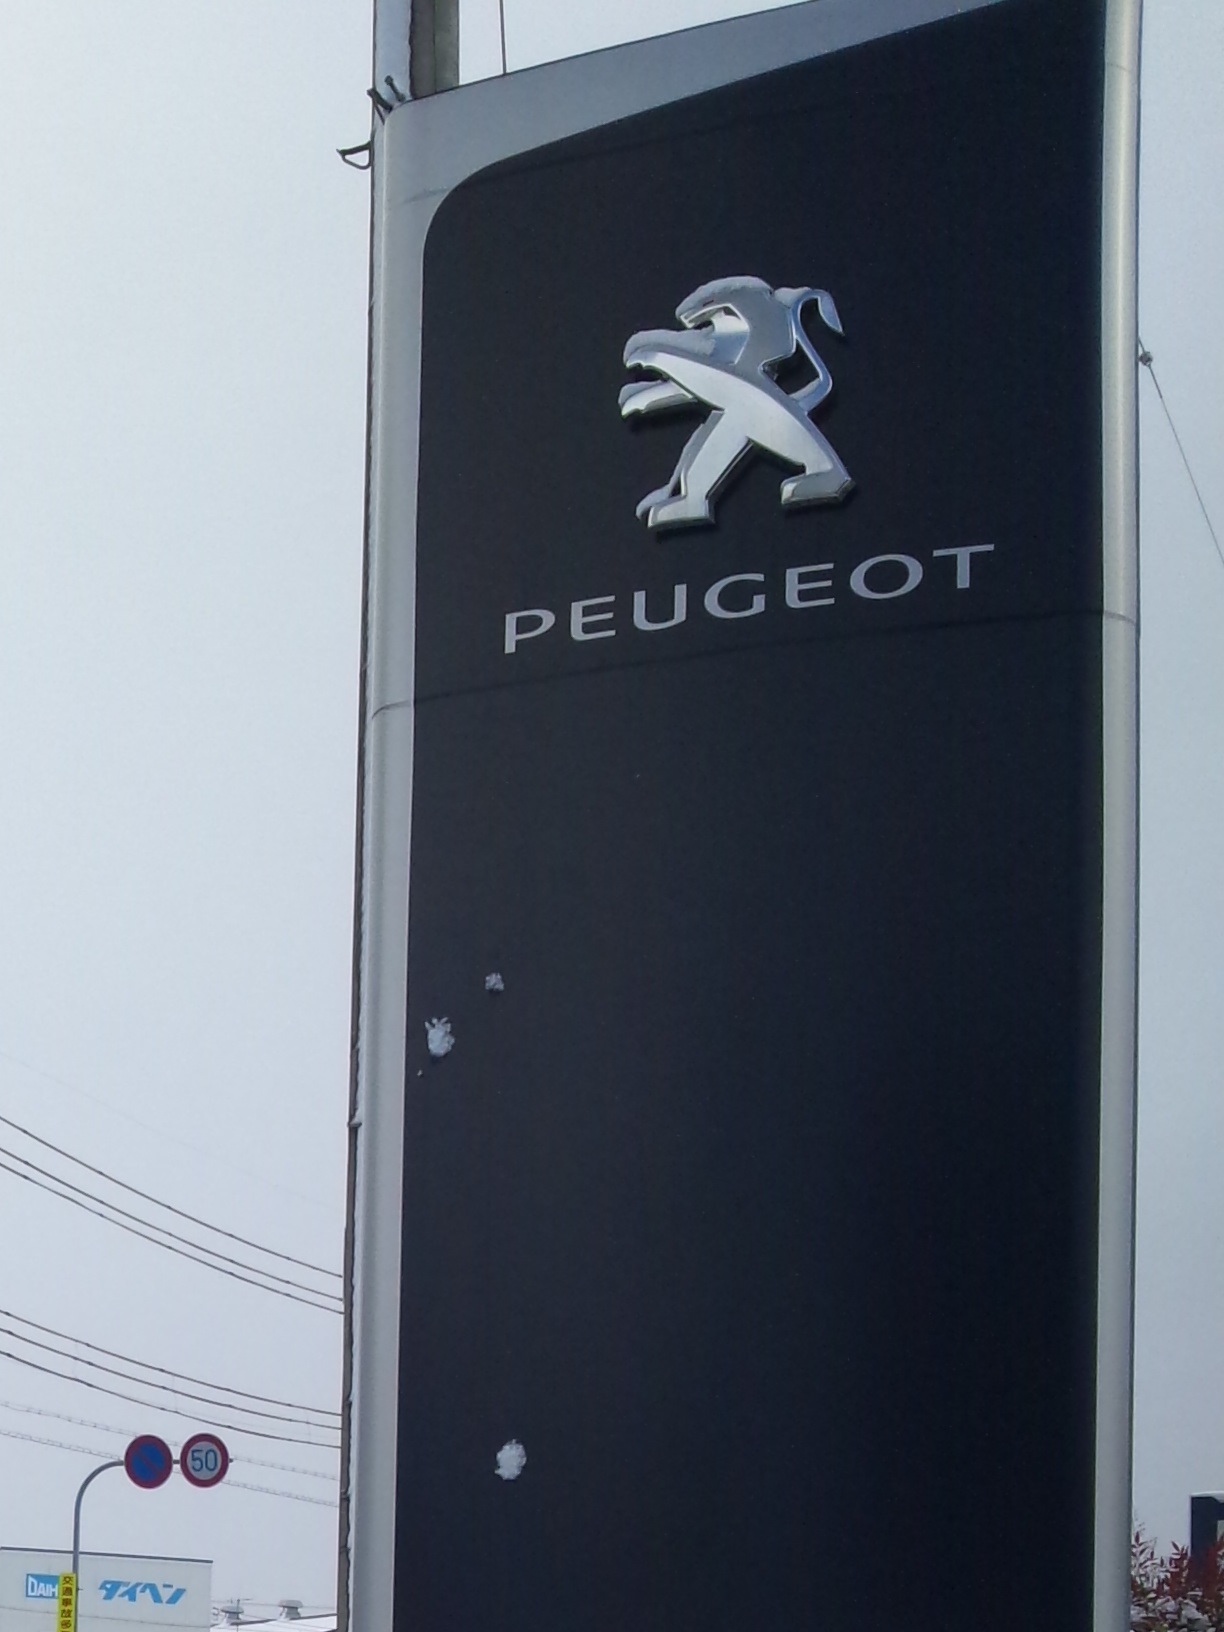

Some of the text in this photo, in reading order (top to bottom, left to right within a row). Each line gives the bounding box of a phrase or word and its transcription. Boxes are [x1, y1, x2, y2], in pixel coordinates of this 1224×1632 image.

[503, 543, 995, 654] PEUGEOT
[190, 1449, 218, 1472] 50
[28, 1575, 58, 1597] DAIH
[98, 1579, 187, 1605] ダイヘン
